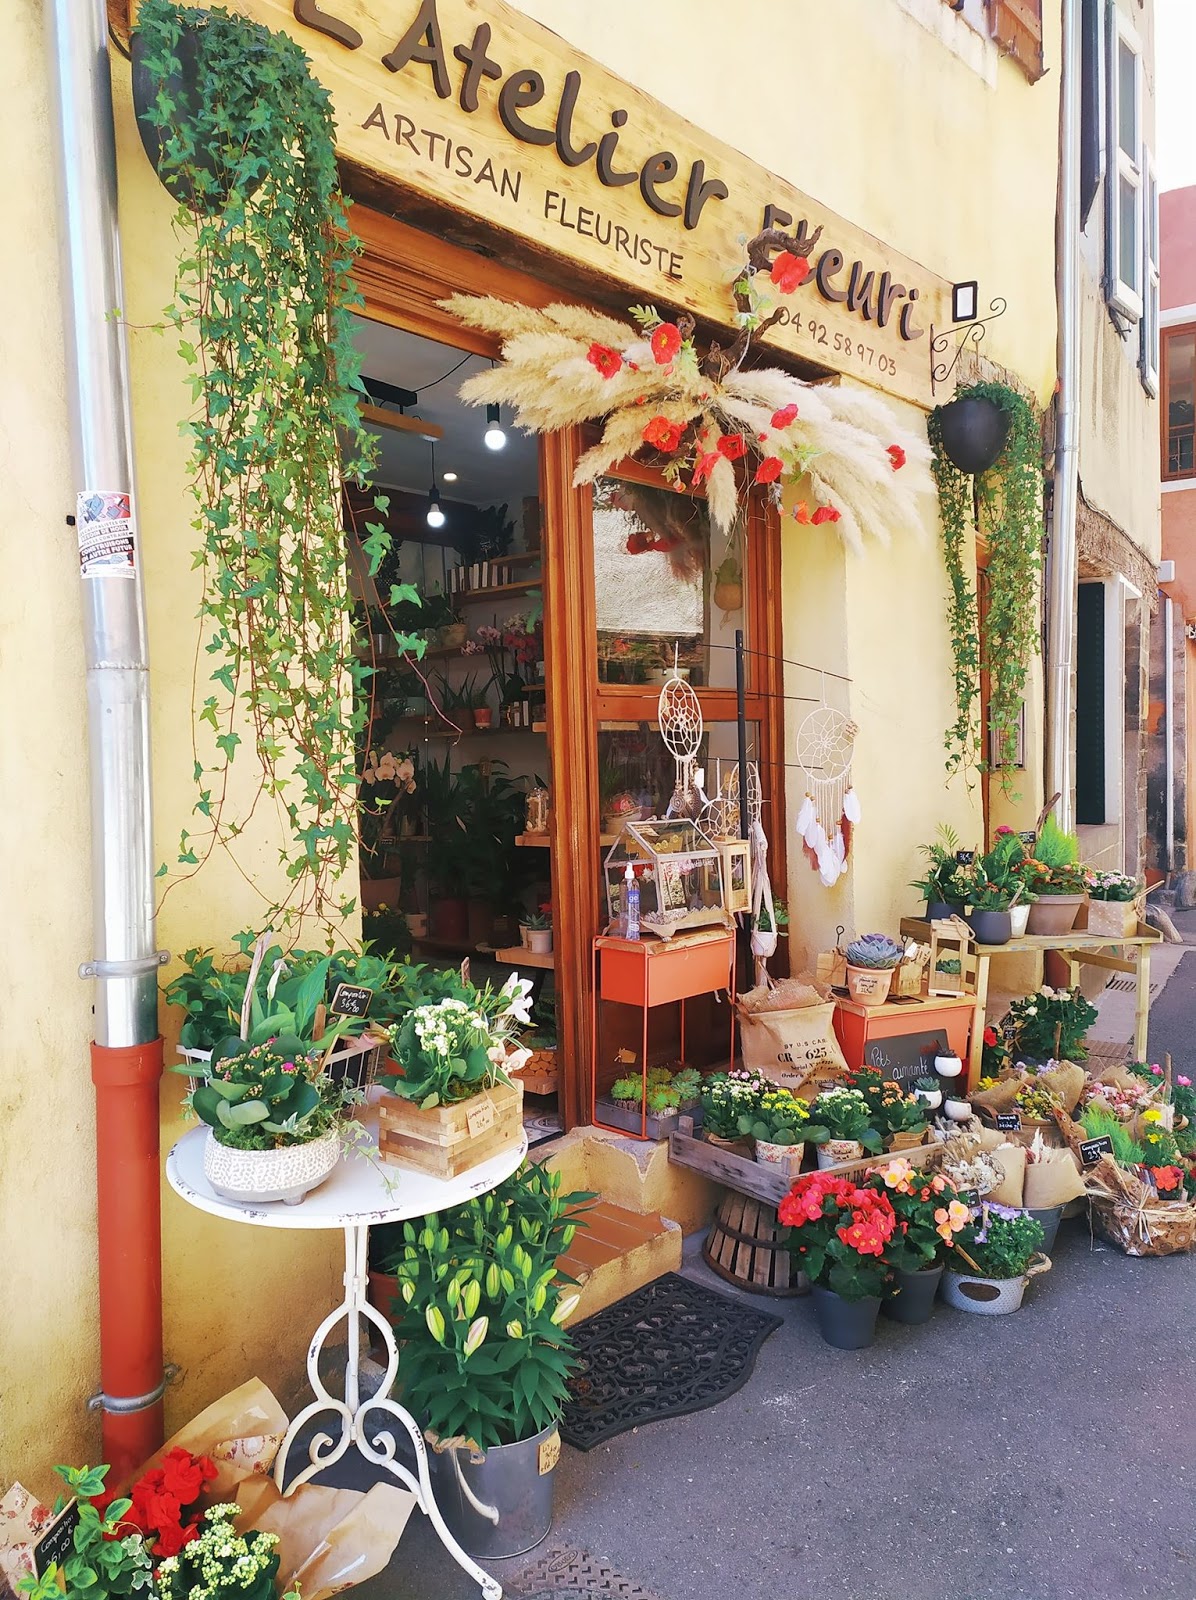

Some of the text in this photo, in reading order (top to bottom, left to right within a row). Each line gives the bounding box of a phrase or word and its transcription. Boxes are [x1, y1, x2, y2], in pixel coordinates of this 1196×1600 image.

[361, 102, 685, 280] ARTISAN FLEURISTE
[778, 306, 897, 376] 04 92 58 97 03
[81, 538, 129, 556] CONSTRUISONS
[89, 548, 111, 560] AUTRE
[111, 544, 133, 553] FUTUR
[805, 1047, 827, 1060] 625
[870, 1046, 891, 1067] Pots
